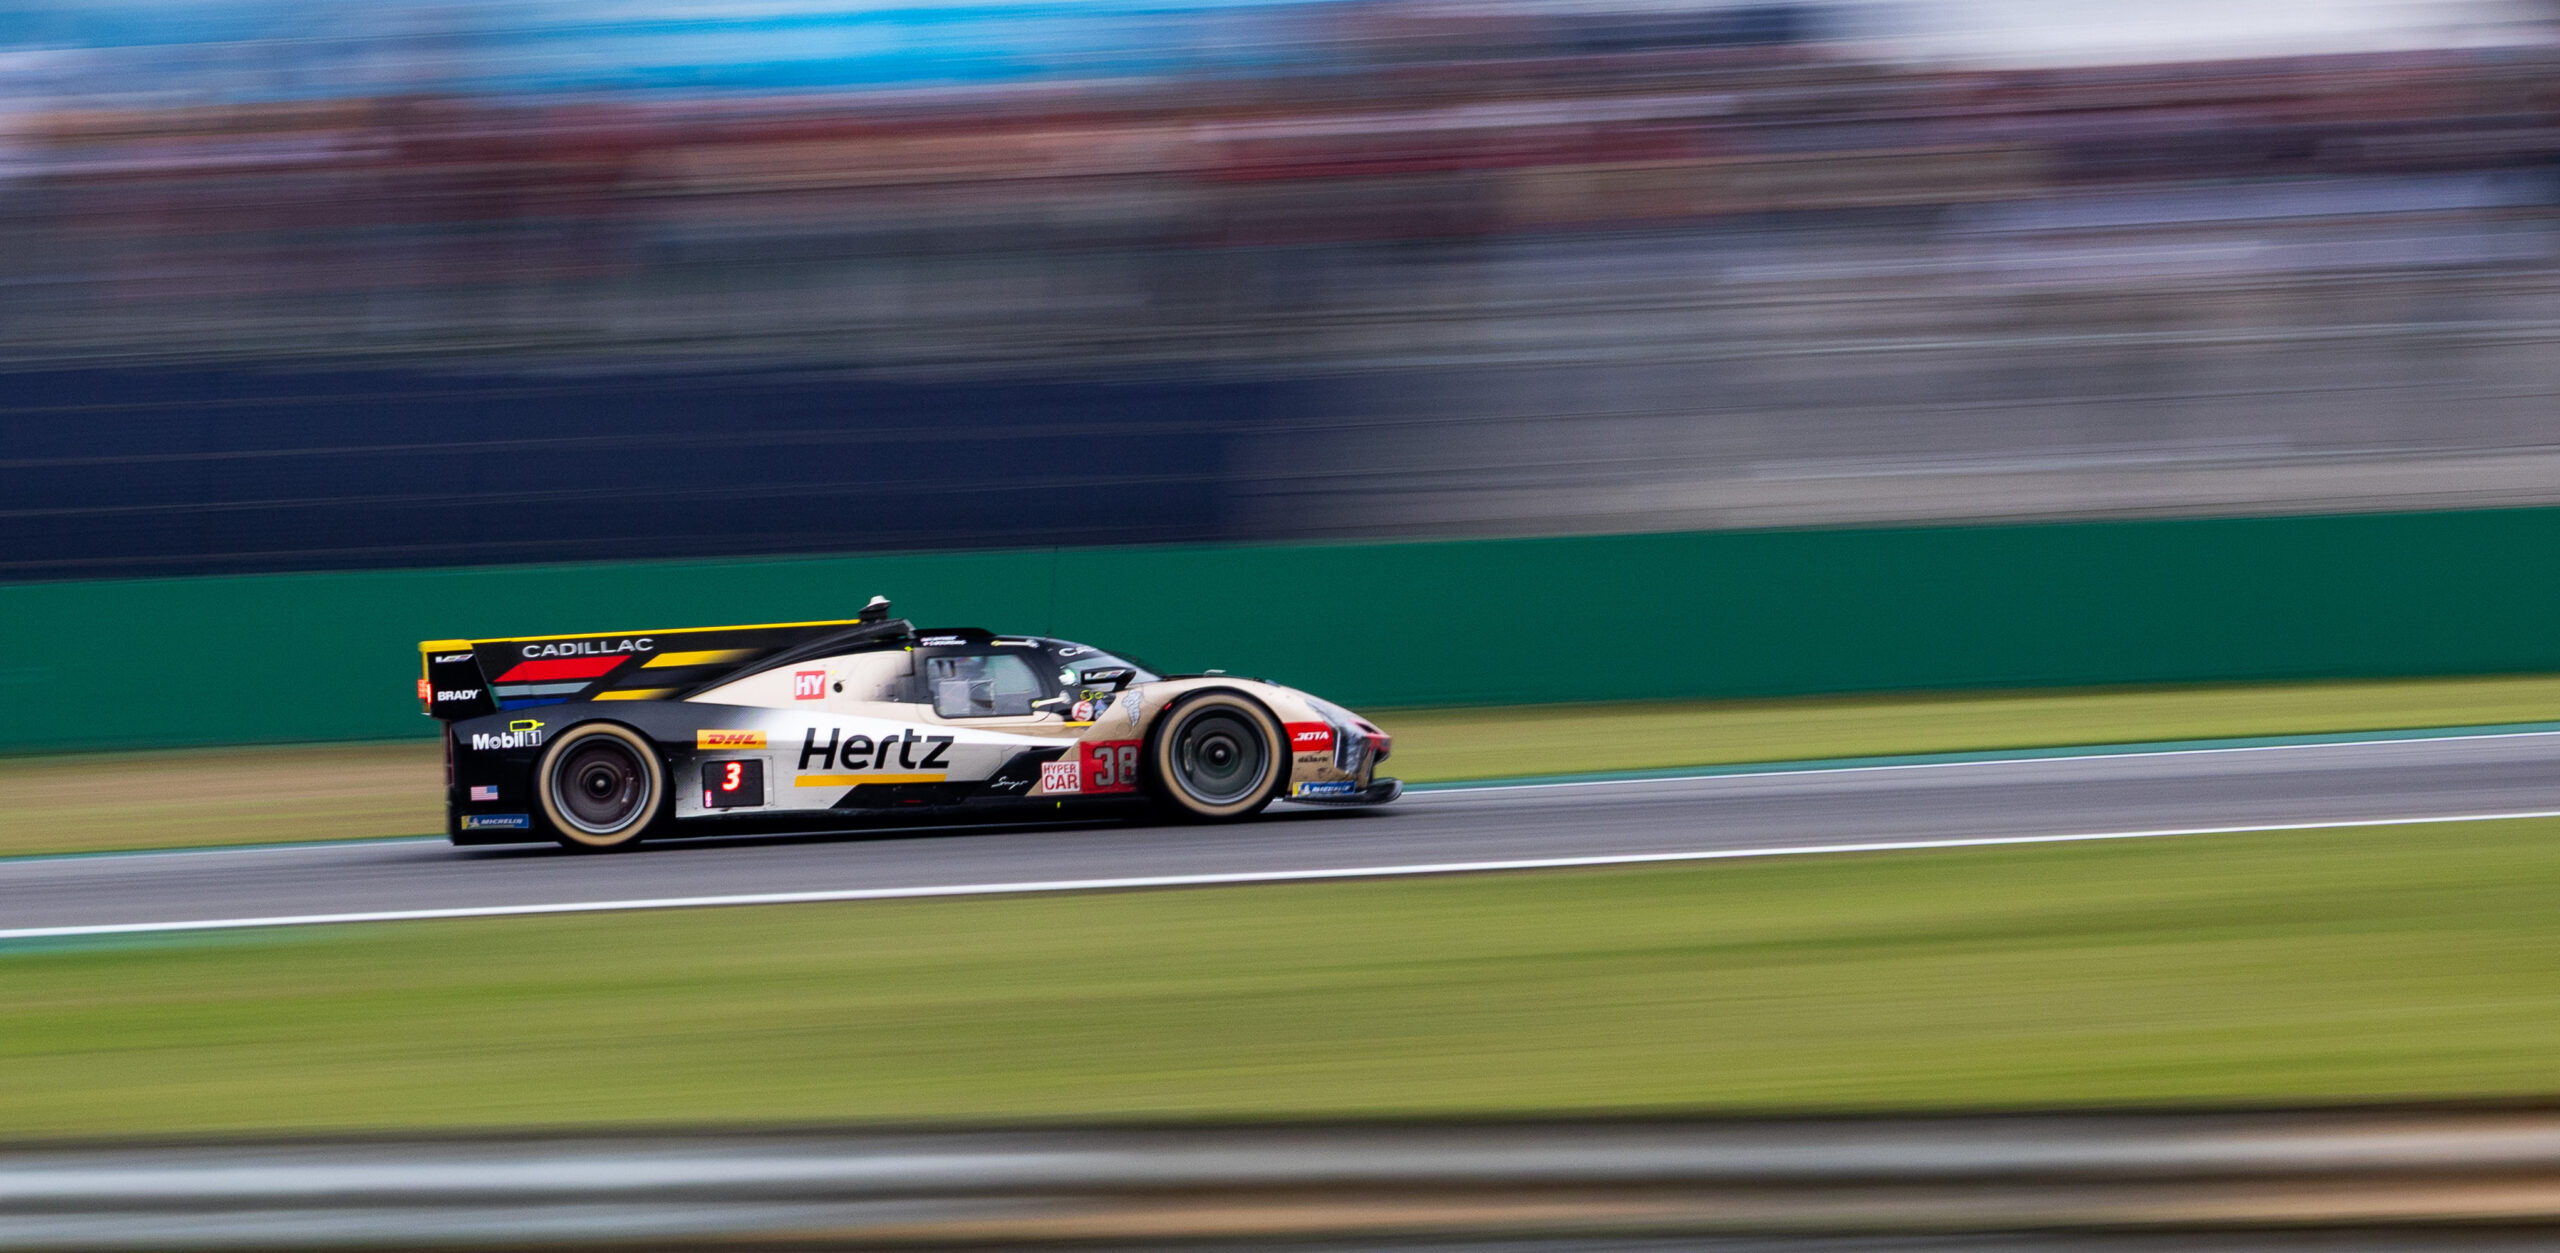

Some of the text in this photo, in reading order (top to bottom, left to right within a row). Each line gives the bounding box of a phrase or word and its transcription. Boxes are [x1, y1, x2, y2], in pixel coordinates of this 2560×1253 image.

[522, 638, 655, 659] CADILLAC
[796, 674, 825, 696] HY
[437, 689, 479, 702] BRADY
[472, 731, 524, 751] Mobil
[707, 734, 757, 745] DHL
[797, 727, 955, 770] Hertz
[721, 761, 742, 792] 3
[1043, 763, 1077, 774] HYPER
[1093, 746, 1138, 787] 38
[1044, 773, 1080, 791] CAR
